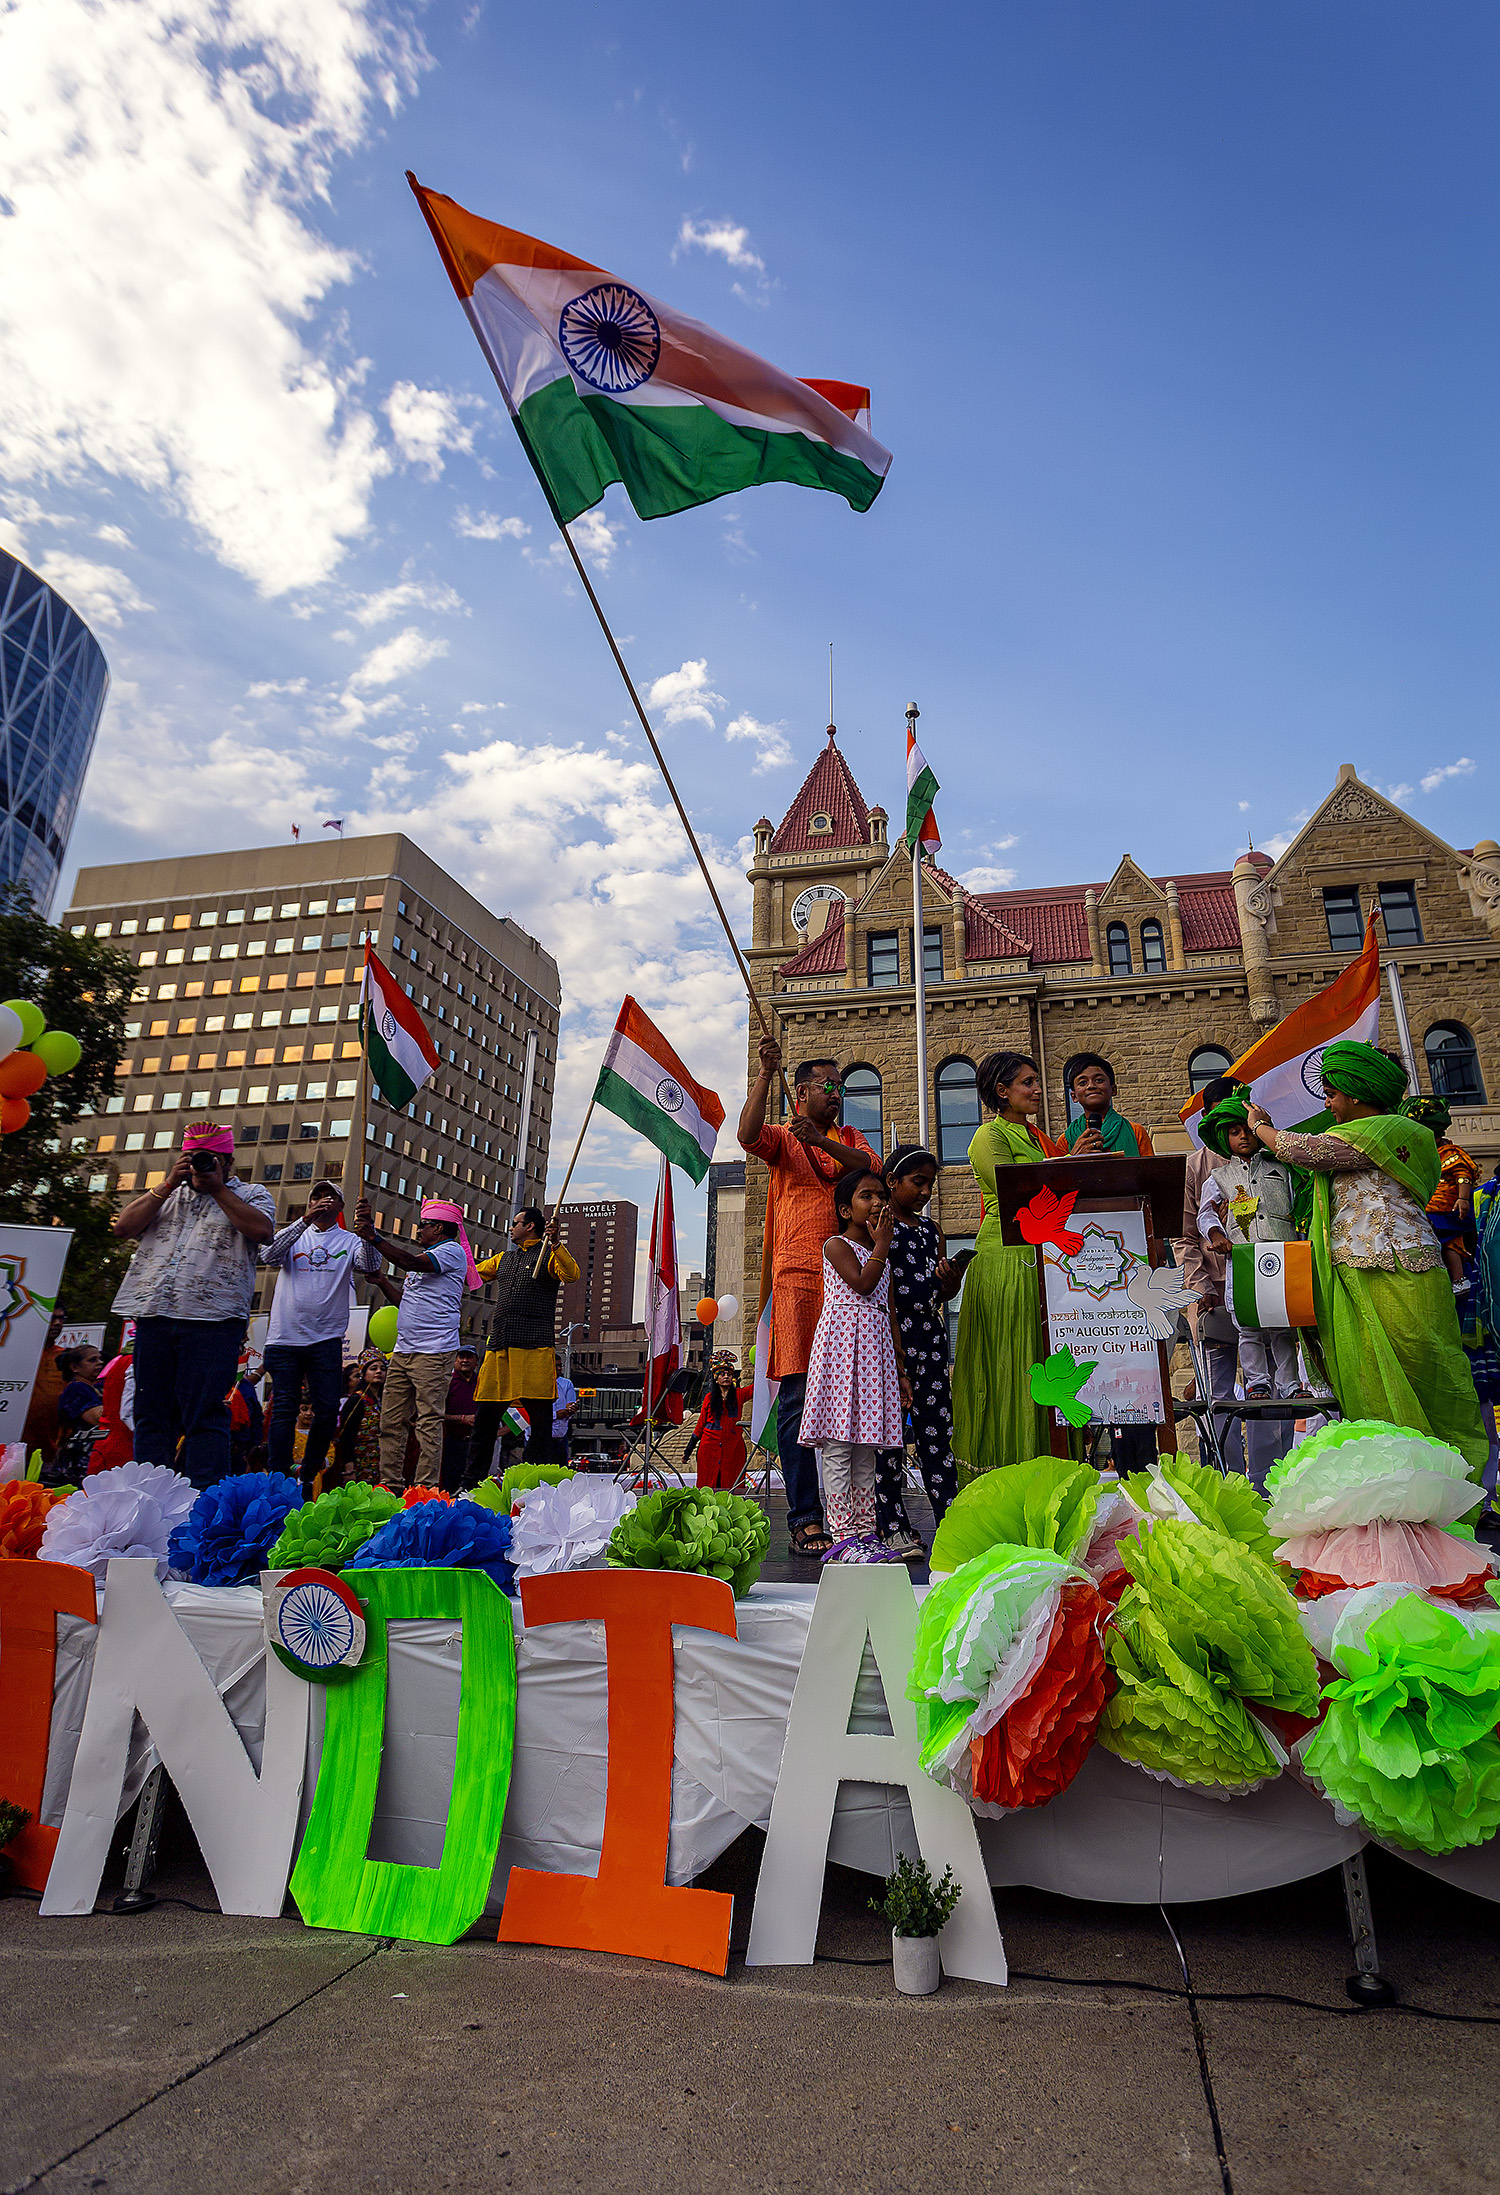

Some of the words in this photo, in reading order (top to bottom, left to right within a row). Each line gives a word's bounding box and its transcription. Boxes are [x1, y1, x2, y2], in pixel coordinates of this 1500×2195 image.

[1457, 1117, 1500, 1132] HALL
[582, 1204, 616, 1212] HOTELS
[1087, 1262, 1104, 1273] Day
[1050, 1308, 1079, 1321] azadi
[1080, 1307, 1095, 1320] ka
[1097, 1307, 1144, 1320] mahotsa
[1055, 1327, 1075, 1338] 15TH
[1076, 1325, 1120, 1337] AUGUST
[1054, 1342, 1098, 1356] Clgary
[1102, 1341, 1126, 1355] City
[1130, 1340, 1155, 1352] Hall
